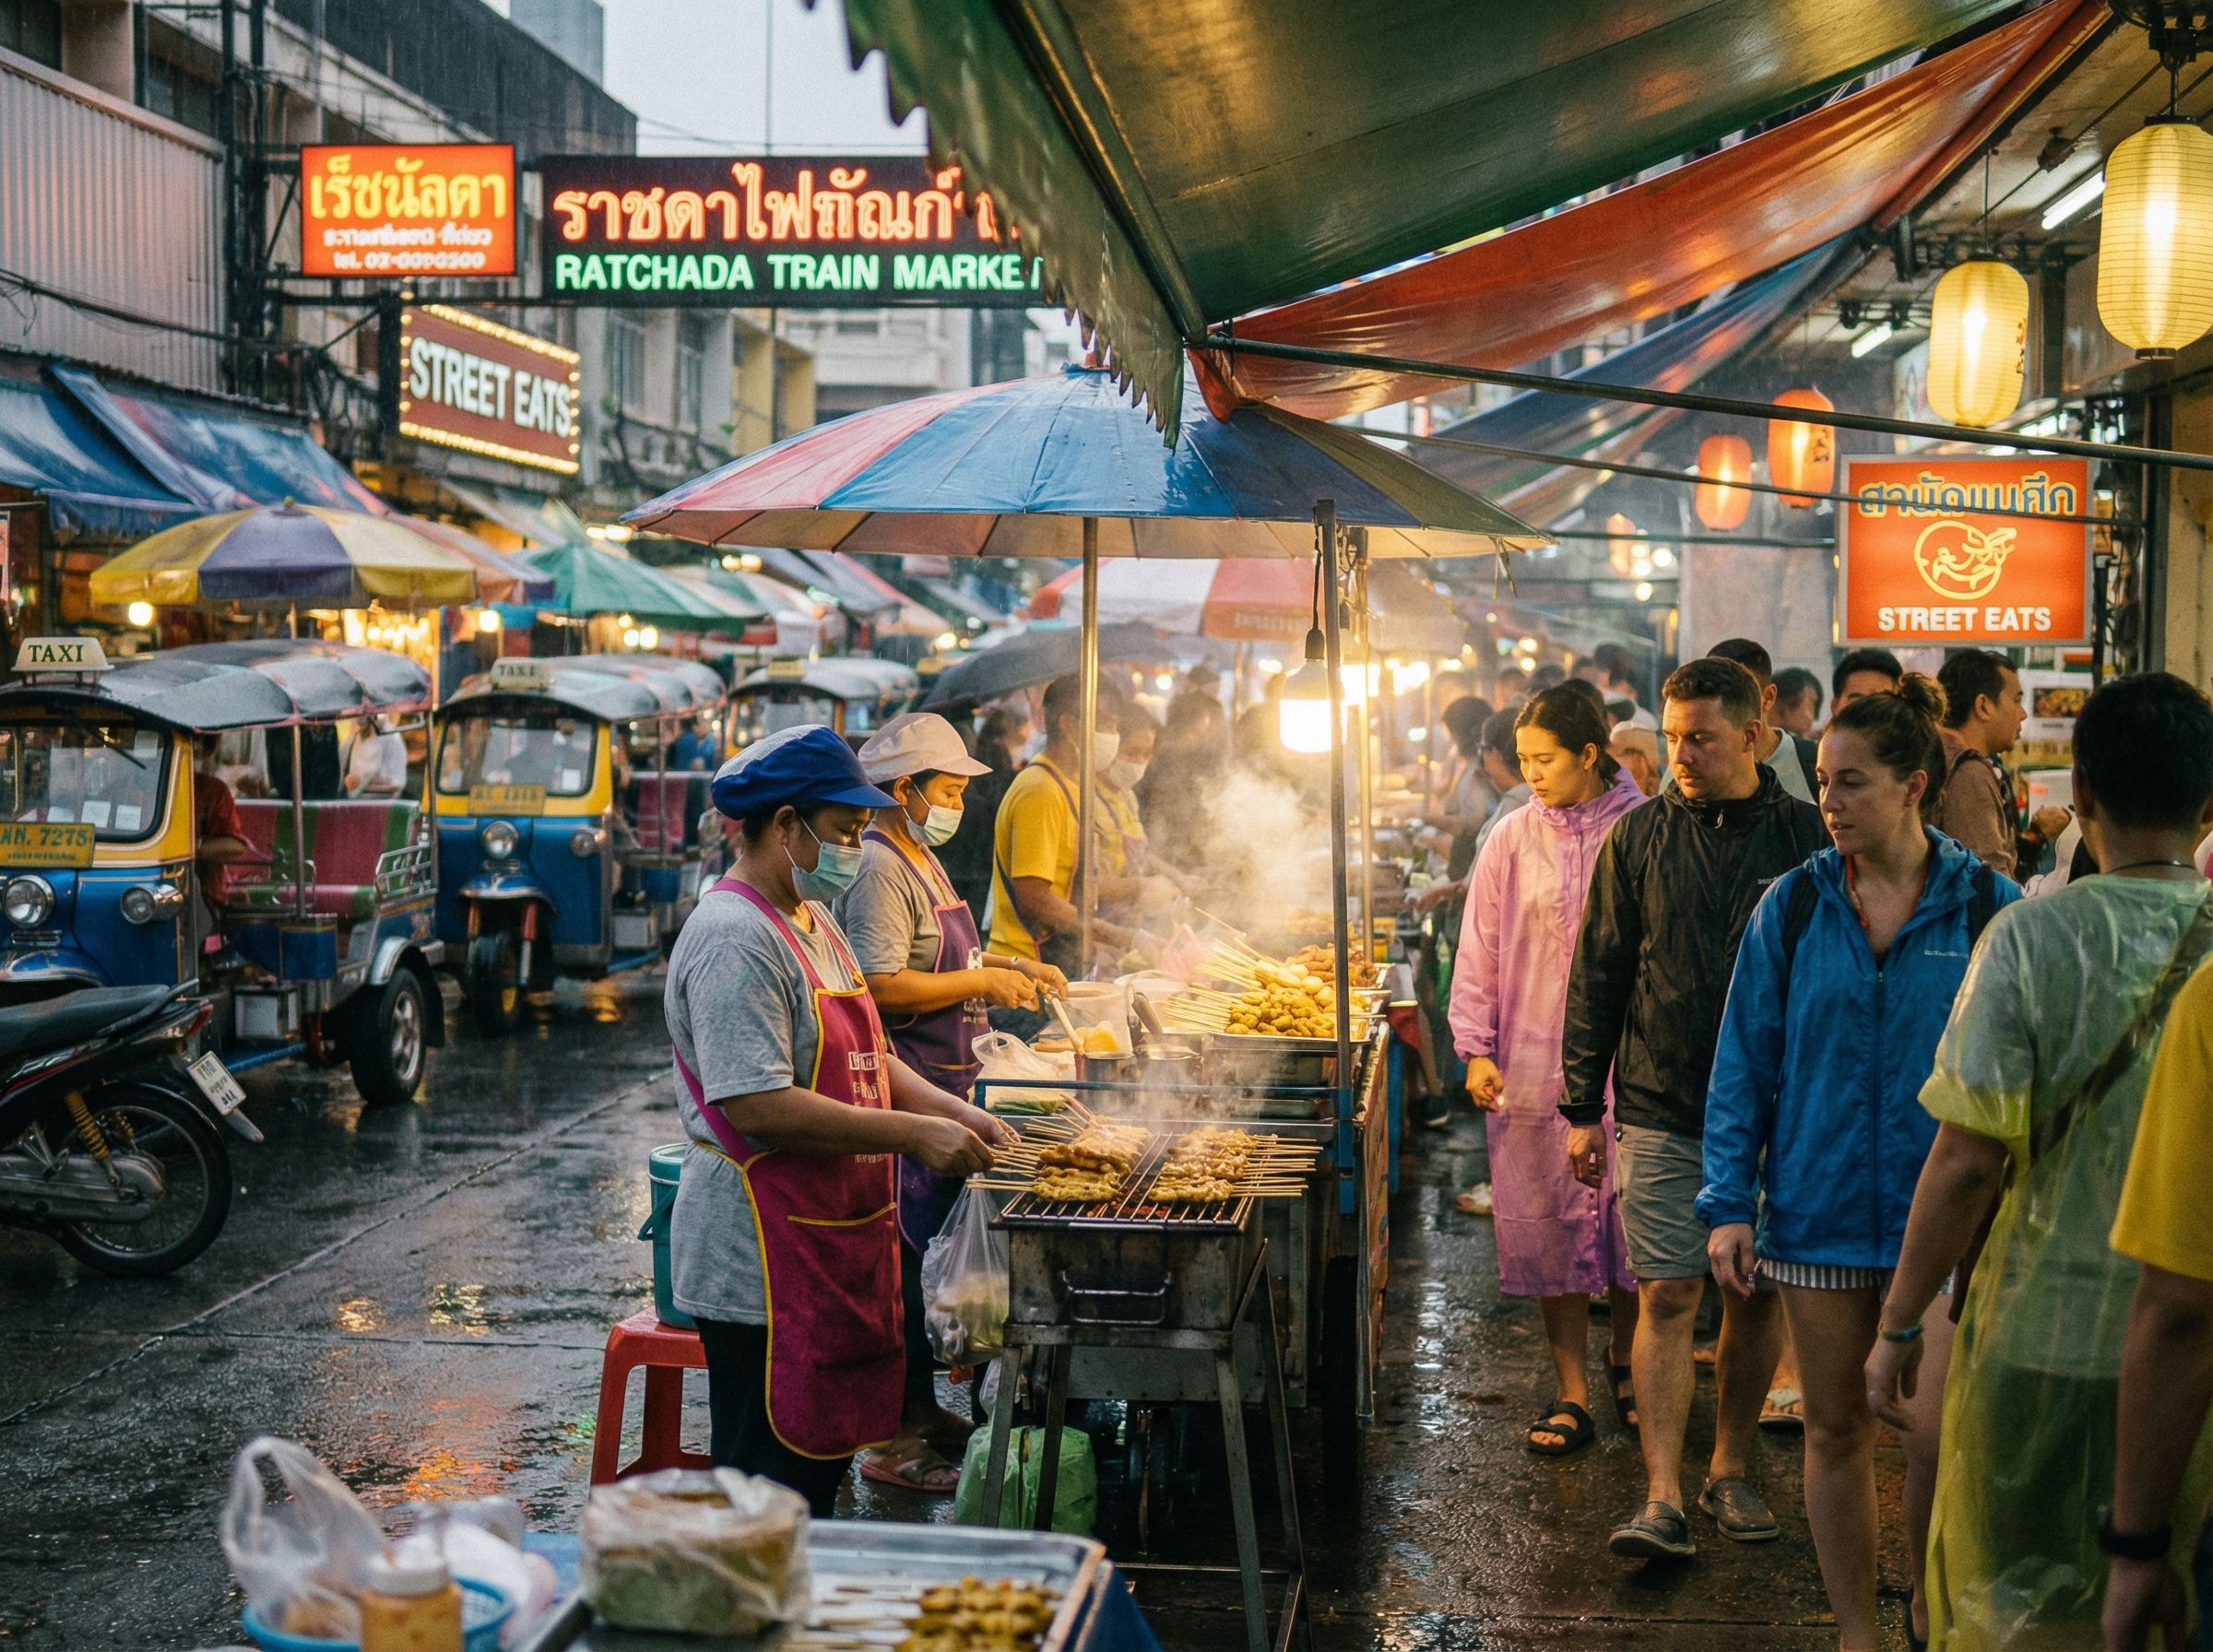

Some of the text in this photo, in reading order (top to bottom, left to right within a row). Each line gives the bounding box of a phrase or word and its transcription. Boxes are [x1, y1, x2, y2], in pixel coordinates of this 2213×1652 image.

[556, 254, 755, 290] RATCHADA
[767, 254, 879, 290] TRAIN
[408, 336, 572, 439] STREET EATS
[1877, 606, 2053, 631] STREET EATS
[28, 644, 84, 663] TAXI
